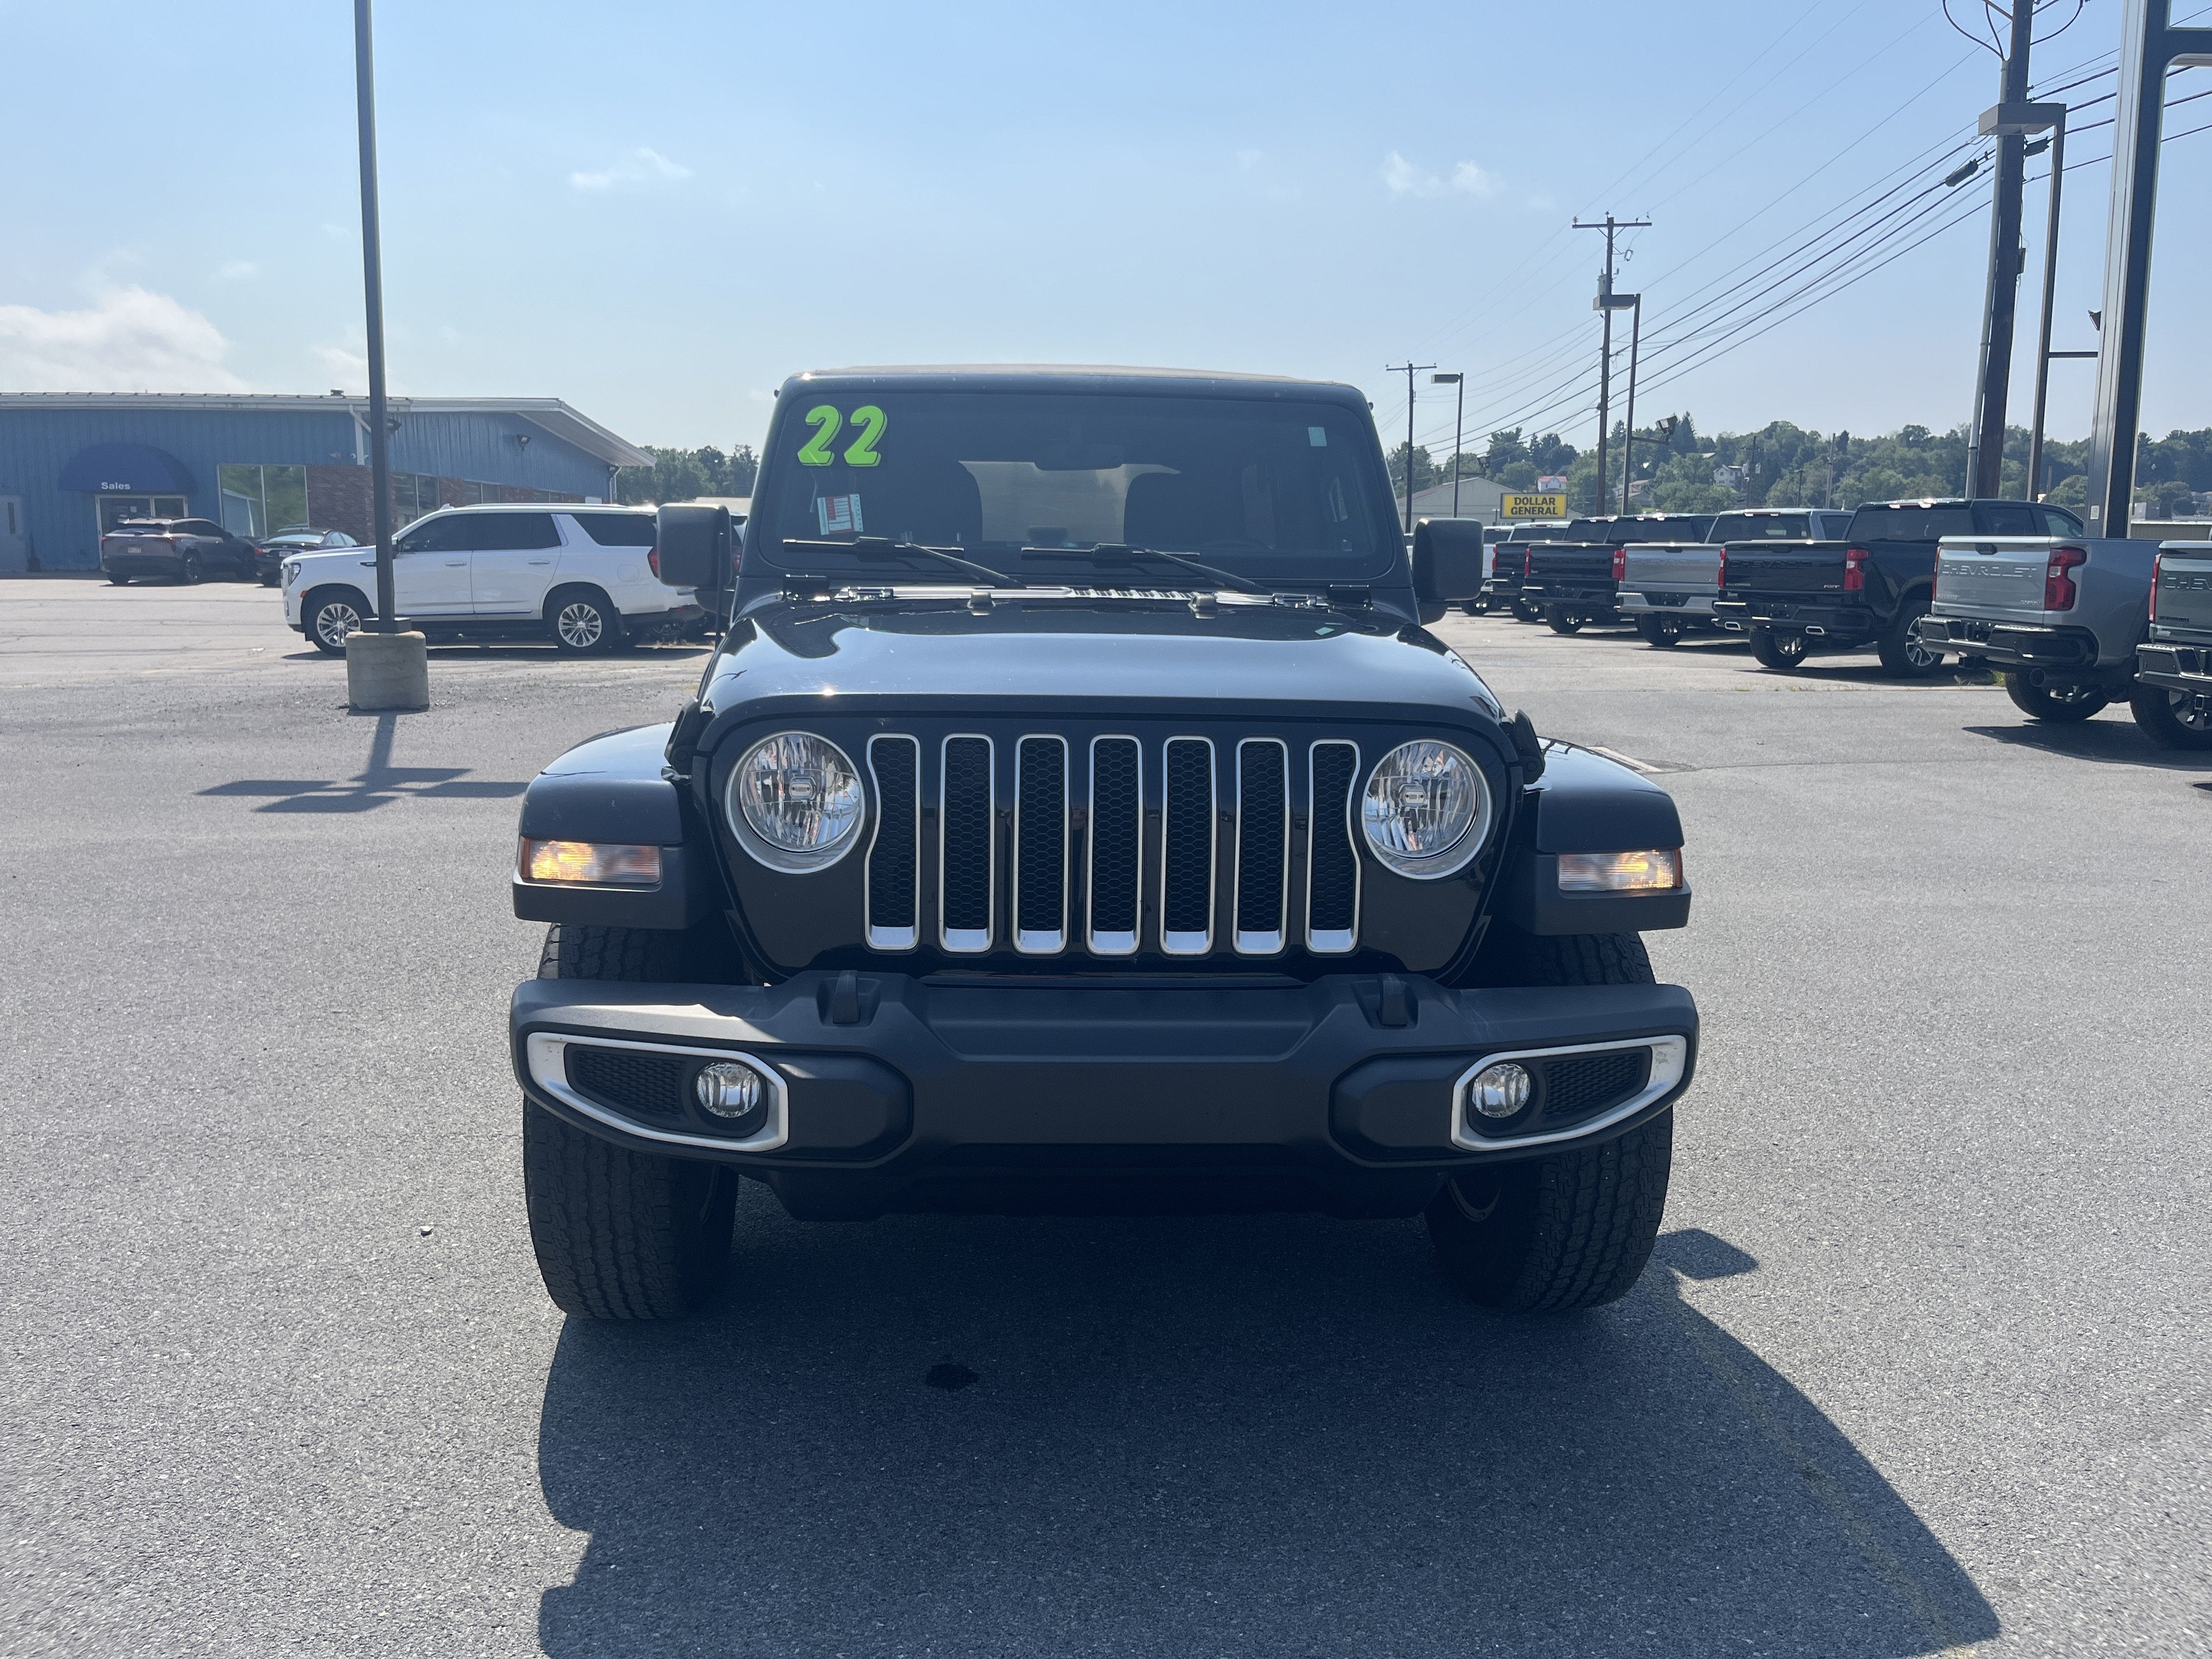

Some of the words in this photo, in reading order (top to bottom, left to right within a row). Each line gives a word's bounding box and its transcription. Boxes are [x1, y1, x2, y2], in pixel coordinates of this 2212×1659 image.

[797, 405, 888, 467] 22
[101, 482, 131, 490] Sales
[1514, 497, 1556, 505] DOLLAR
[1511, 506, 1558, 515] GENERAL
[1942, 564, 2037, 578] CHEVROLET
